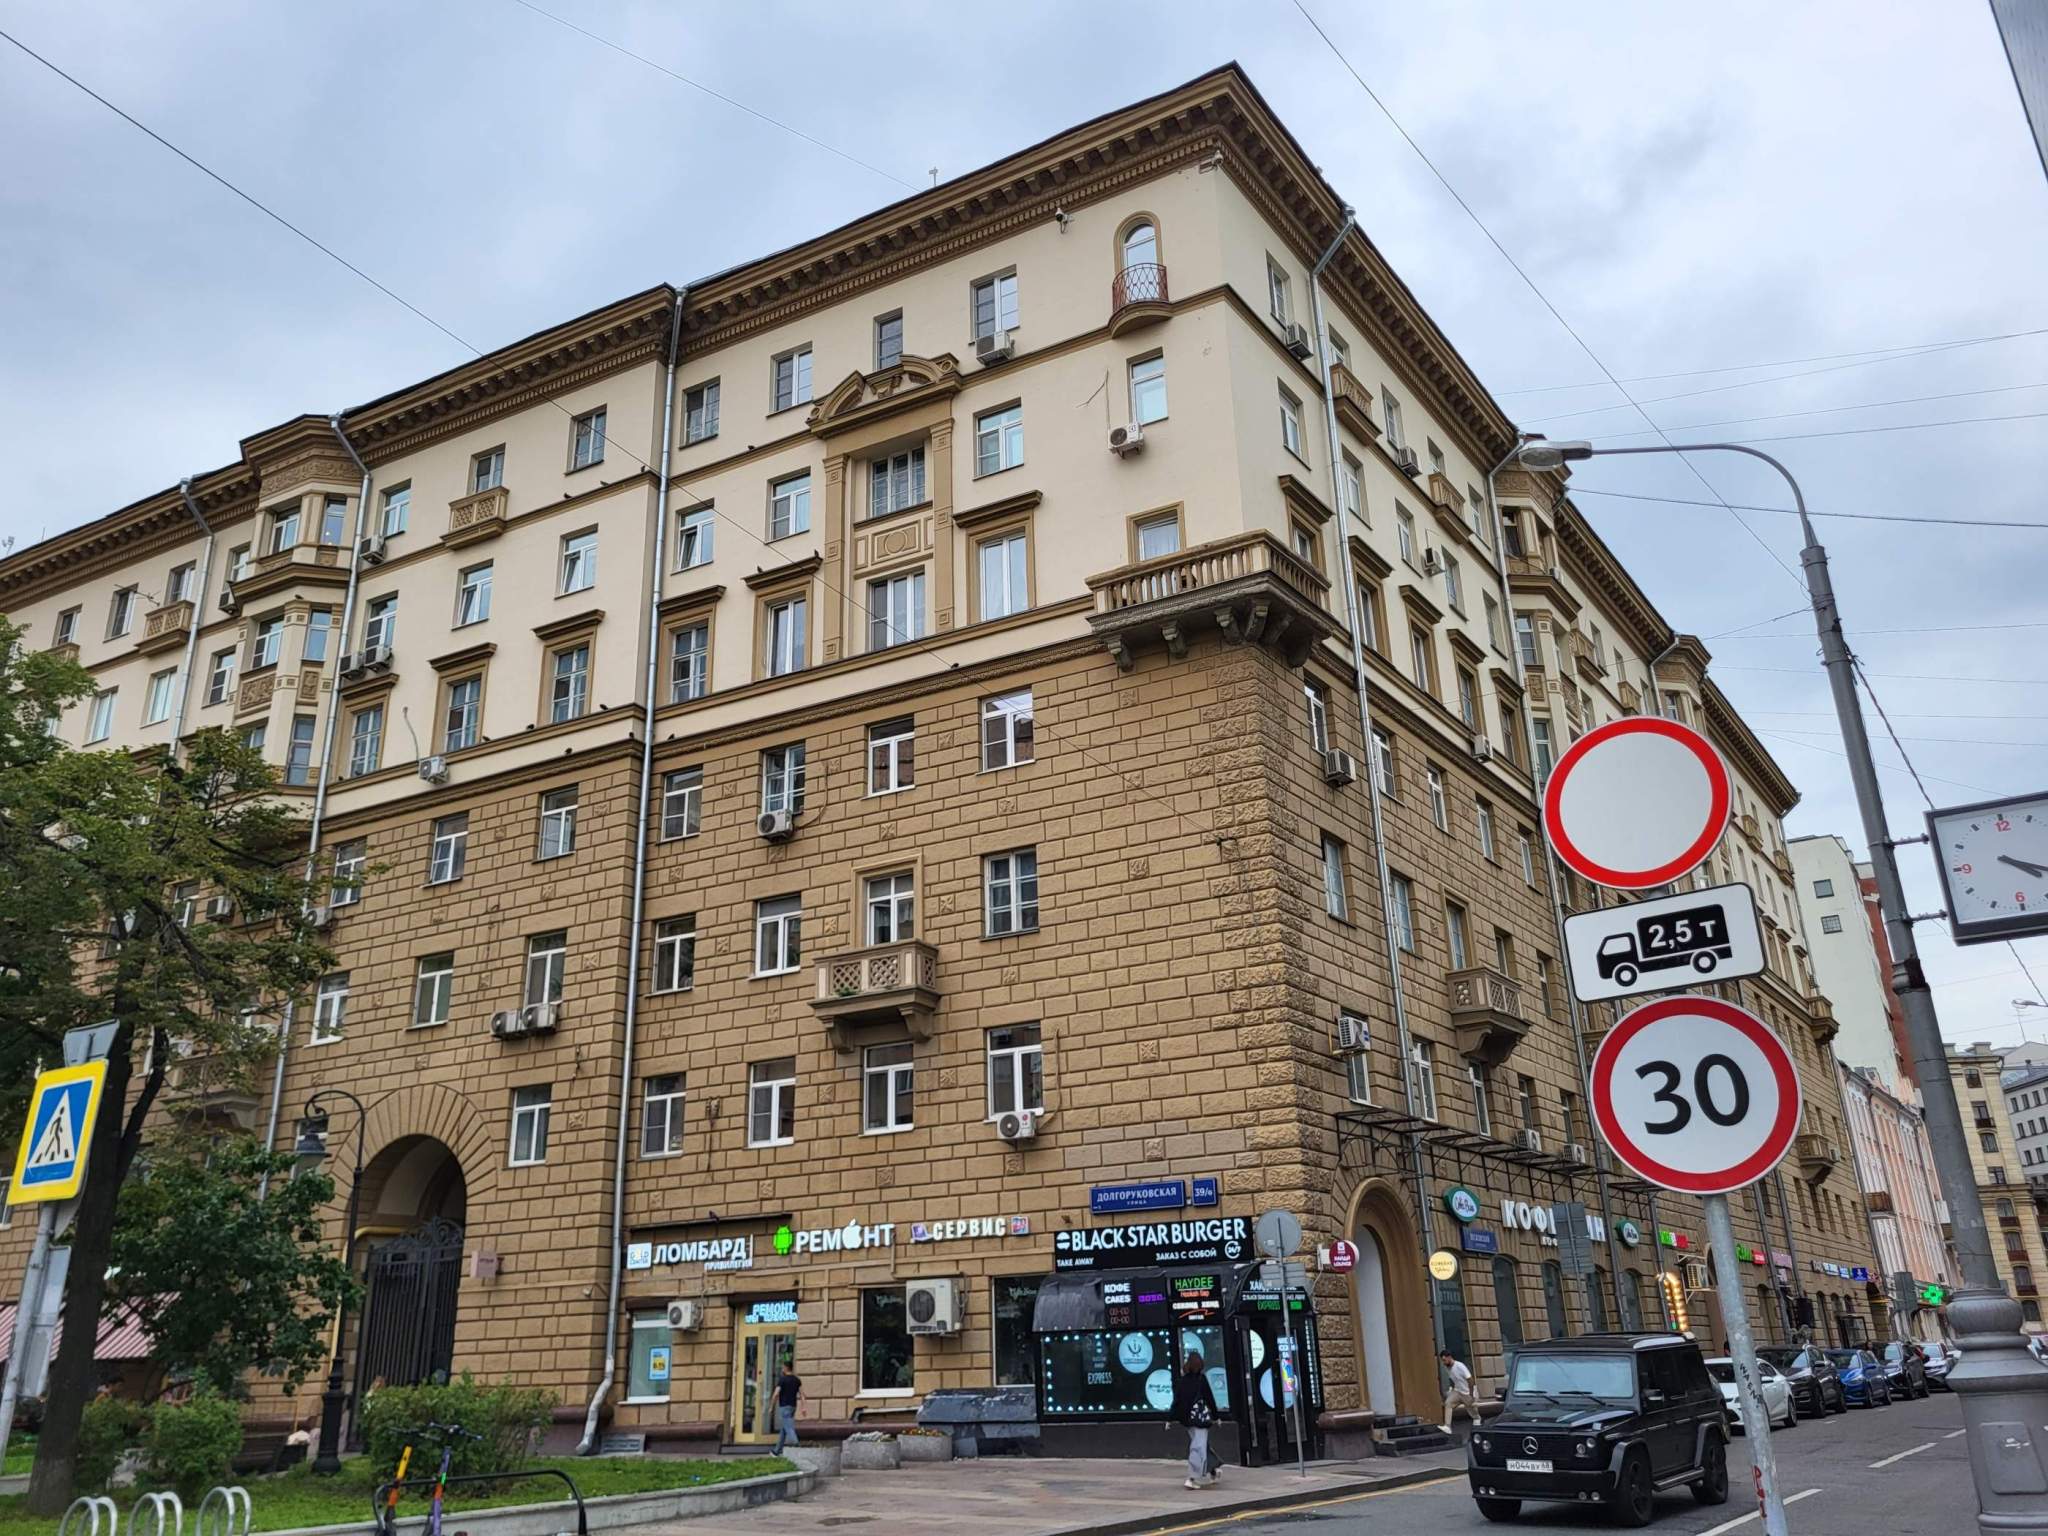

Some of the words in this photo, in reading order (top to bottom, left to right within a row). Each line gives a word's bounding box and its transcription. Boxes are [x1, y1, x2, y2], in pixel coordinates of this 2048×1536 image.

[1995, 820, 2012, 832] 12
[1961, 863, 1972, 874] 9
[2015, 891, 2025, 902] 6
[1648, 919, 1692, 950] 2,5
[1635, 1053, 1750, 1135] 30
[1097, 1186, 1177, 1203] ДОЛГОРУКОВСКАЯ
[932, 1217, 1006, 1241] СЕРВИС
[1071, 1227, 1125, 1251] BLACK
[1127, 1223, 1169, 1247] STAR
[1171, 1218, 1247, 1243] BURGER
[653, 1237, 746, 1265] ЛОМБАРД
[1156, 1252, 1180, 1261] ЗАКАЗ
[1188, 1247, 1217, 1259] СОБОЙ
[1057, 1259, 1073, 1267] TAKE
[1074, 1258, 1095, 1266] AWAY
[1104, 1282, 1131, 1293] КОФЕ
[1175, 1276, 1214, 1289] HAYDEE
[1104, 1294, 1132, 1304] CAKES
[752, 1301, 796, 1317] РЕМОНТ
